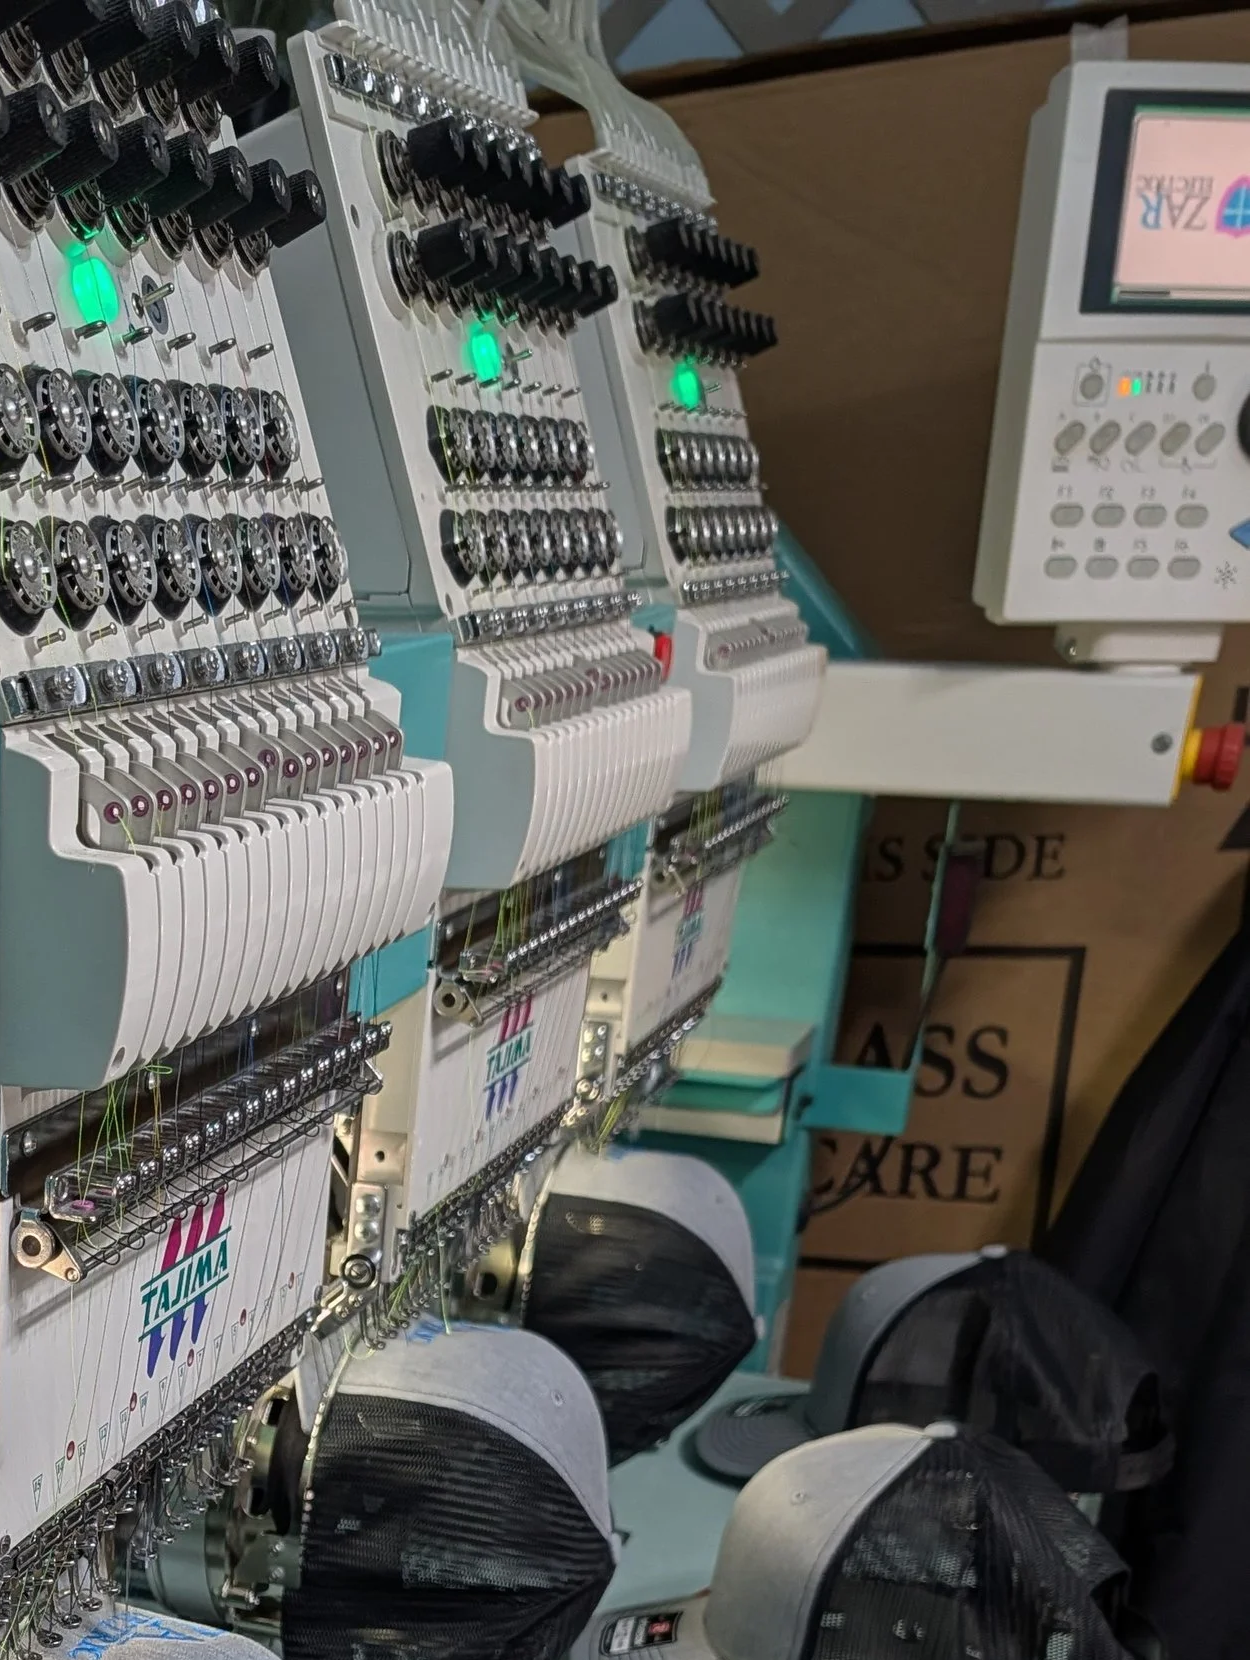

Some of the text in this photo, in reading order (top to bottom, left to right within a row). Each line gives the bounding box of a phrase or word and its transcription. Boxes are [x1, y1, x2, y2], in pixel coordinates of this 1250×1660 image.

[1140, 192, 1211, 231] ZAR
[920, 832, 1066, 883] SDE
[141, 1238, 228, 1328] TAJIMA
